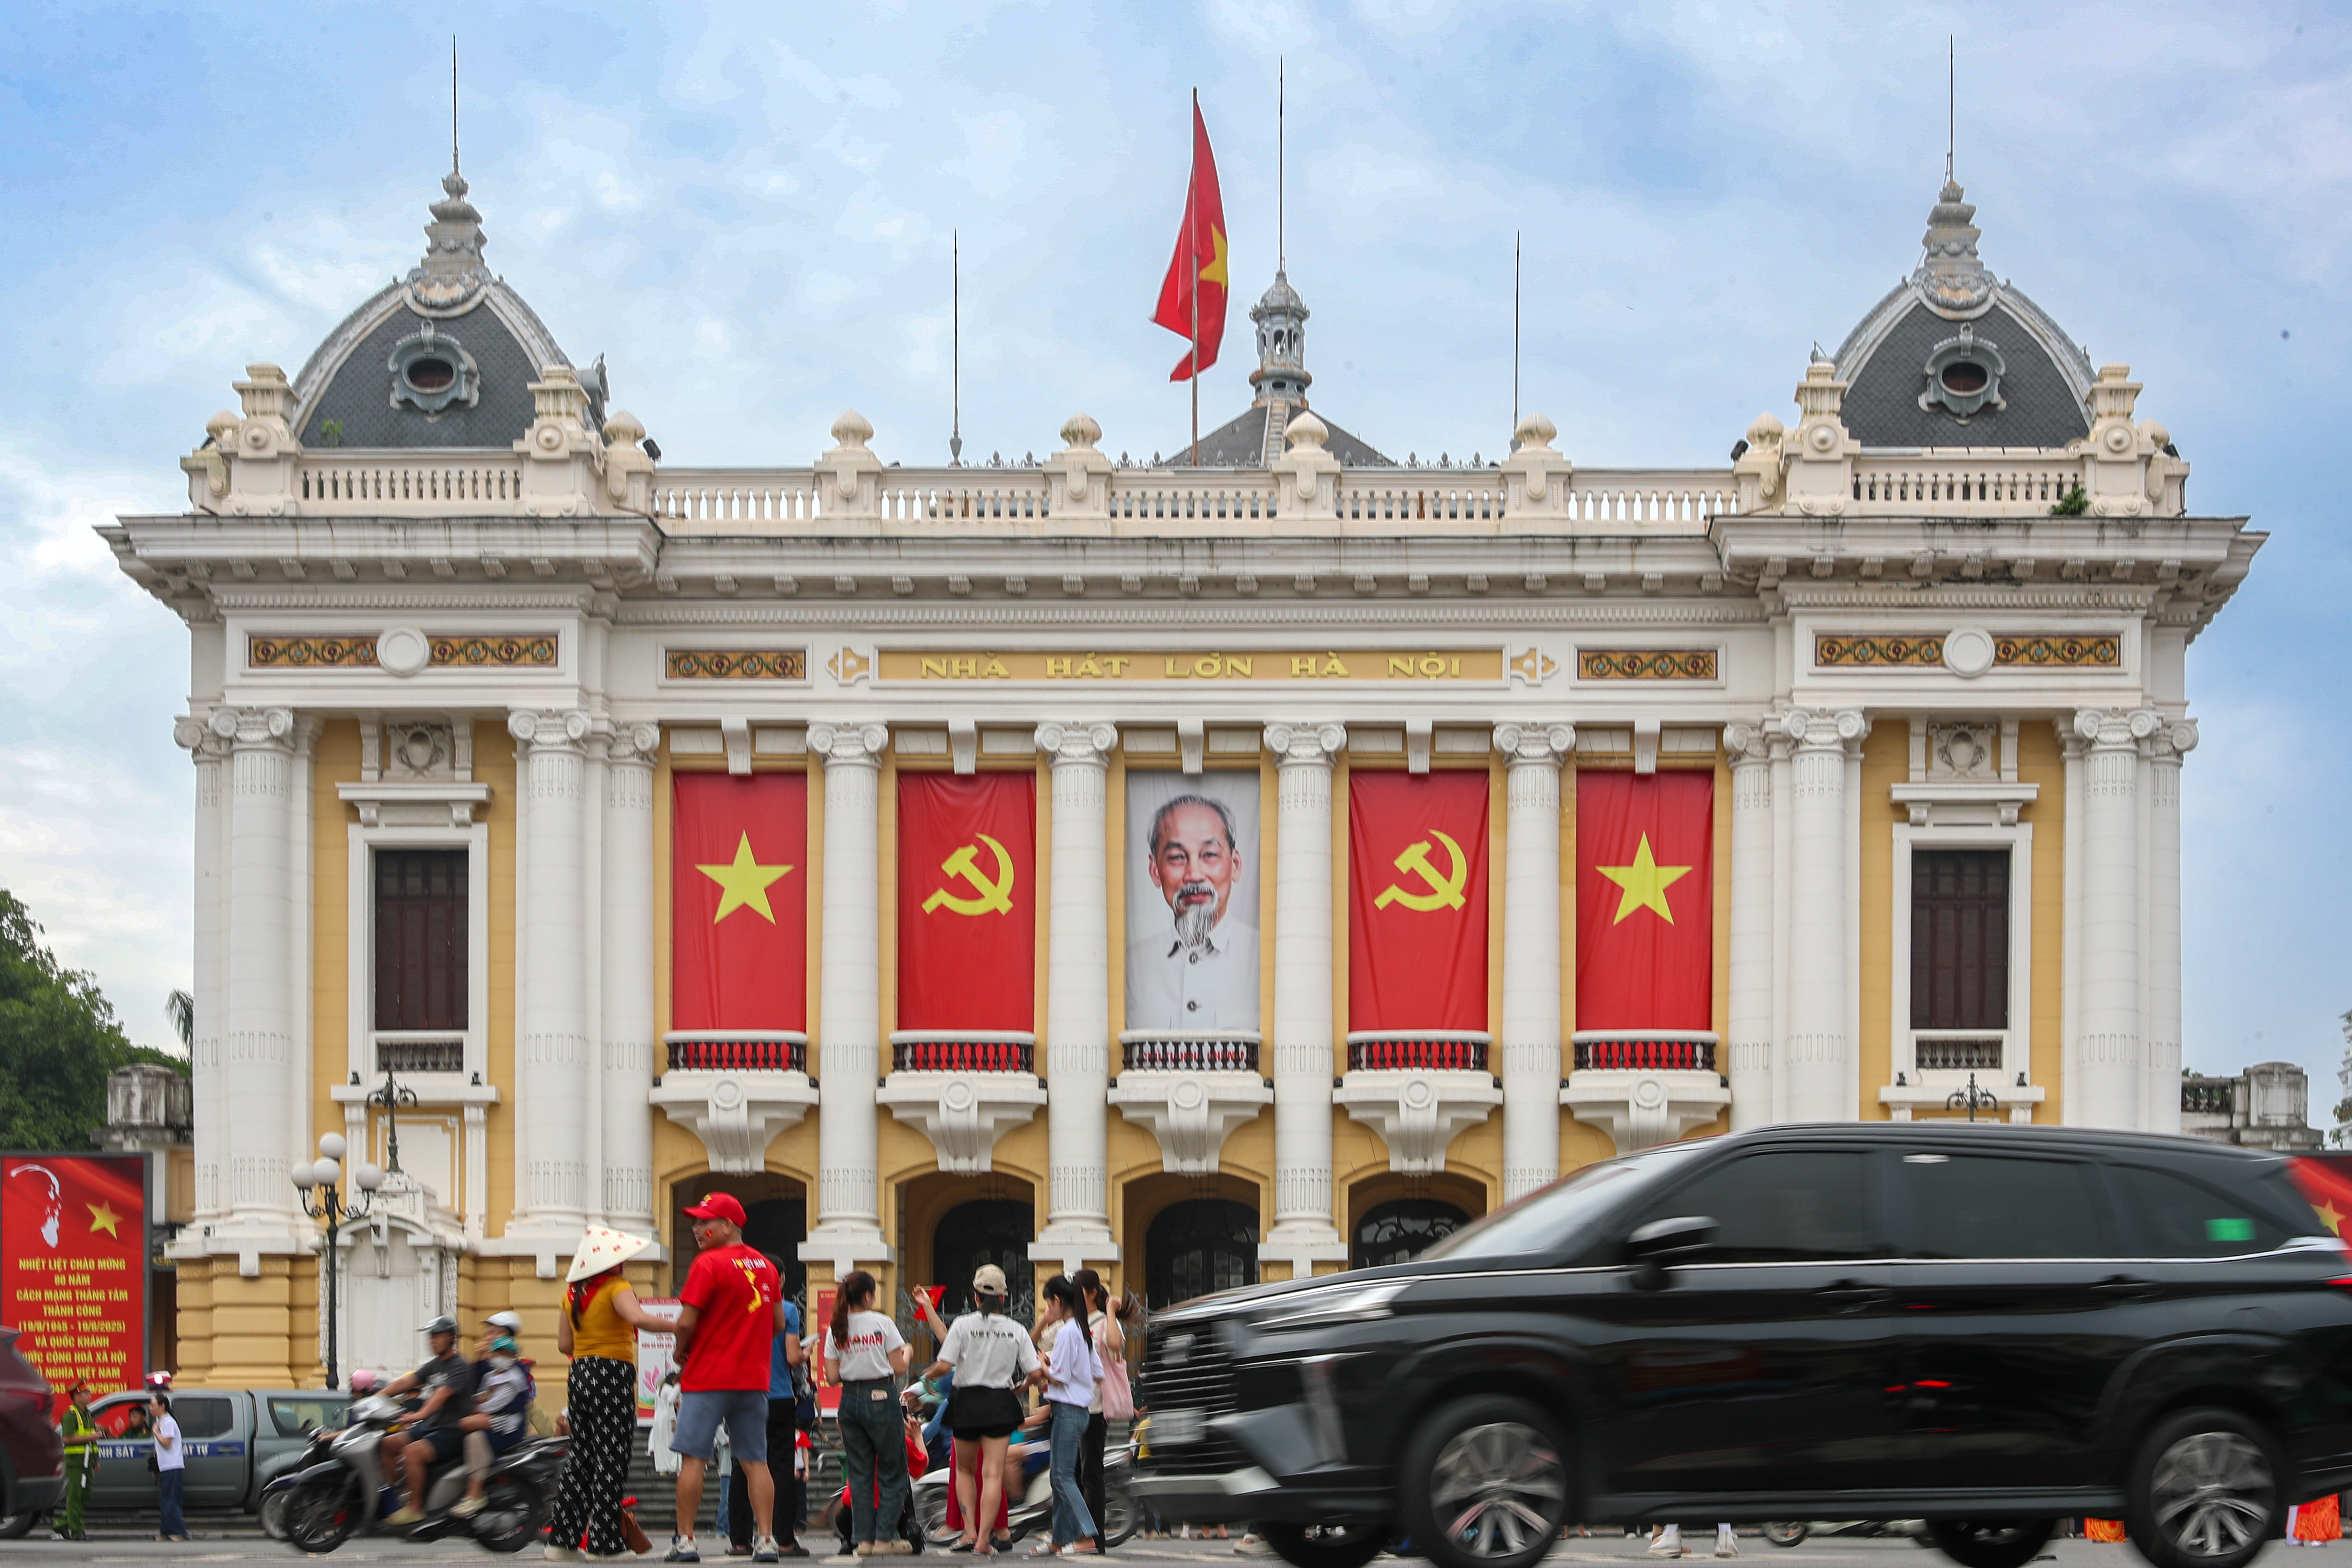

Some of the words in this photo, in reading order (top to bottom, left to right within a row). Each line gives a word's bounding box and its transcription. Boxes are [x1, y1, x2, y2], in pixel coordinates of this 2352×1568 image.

[921, 651, 1010, 678] NHÀ
[1046, 651, 1130, 678] HÁT
[1164, 651, 1252, 678] LỚN
[1291, 650, 1349, 678] HÀ
[1388, 651, 1461, 681] NỘI
[19, 1256, 46, 1272] NHIỆT
[49, 1256, 67, 1272] LIỆT
[70, 1256, 95, 1270] CHÀO
[97, 1256, 126, 1270] MỪNG
[54, 1274, 66, 1286] 80
[16, 1287, 42, 1301] CÁCH
[44, 1289, 73, 1303] MẠNG
[74, 1287, 106, 1301] THÁNG
[108, 1287, 128, 1301] TÁM
[43, 1301, 74, 1317] THÀNH
[76, 1302, 102, 1317] CÔNG
[35, 1333, 47, 1348] VÀ
[77, 1333, 109, 1348] KHÁNH
[46, 1349, 72, 1365] CỘNG
[76, 1364, 96, 1381] VIỆT
[98, 1366, 121, 1379] NAM
[115, 1444, 134, 1458] SÁT
